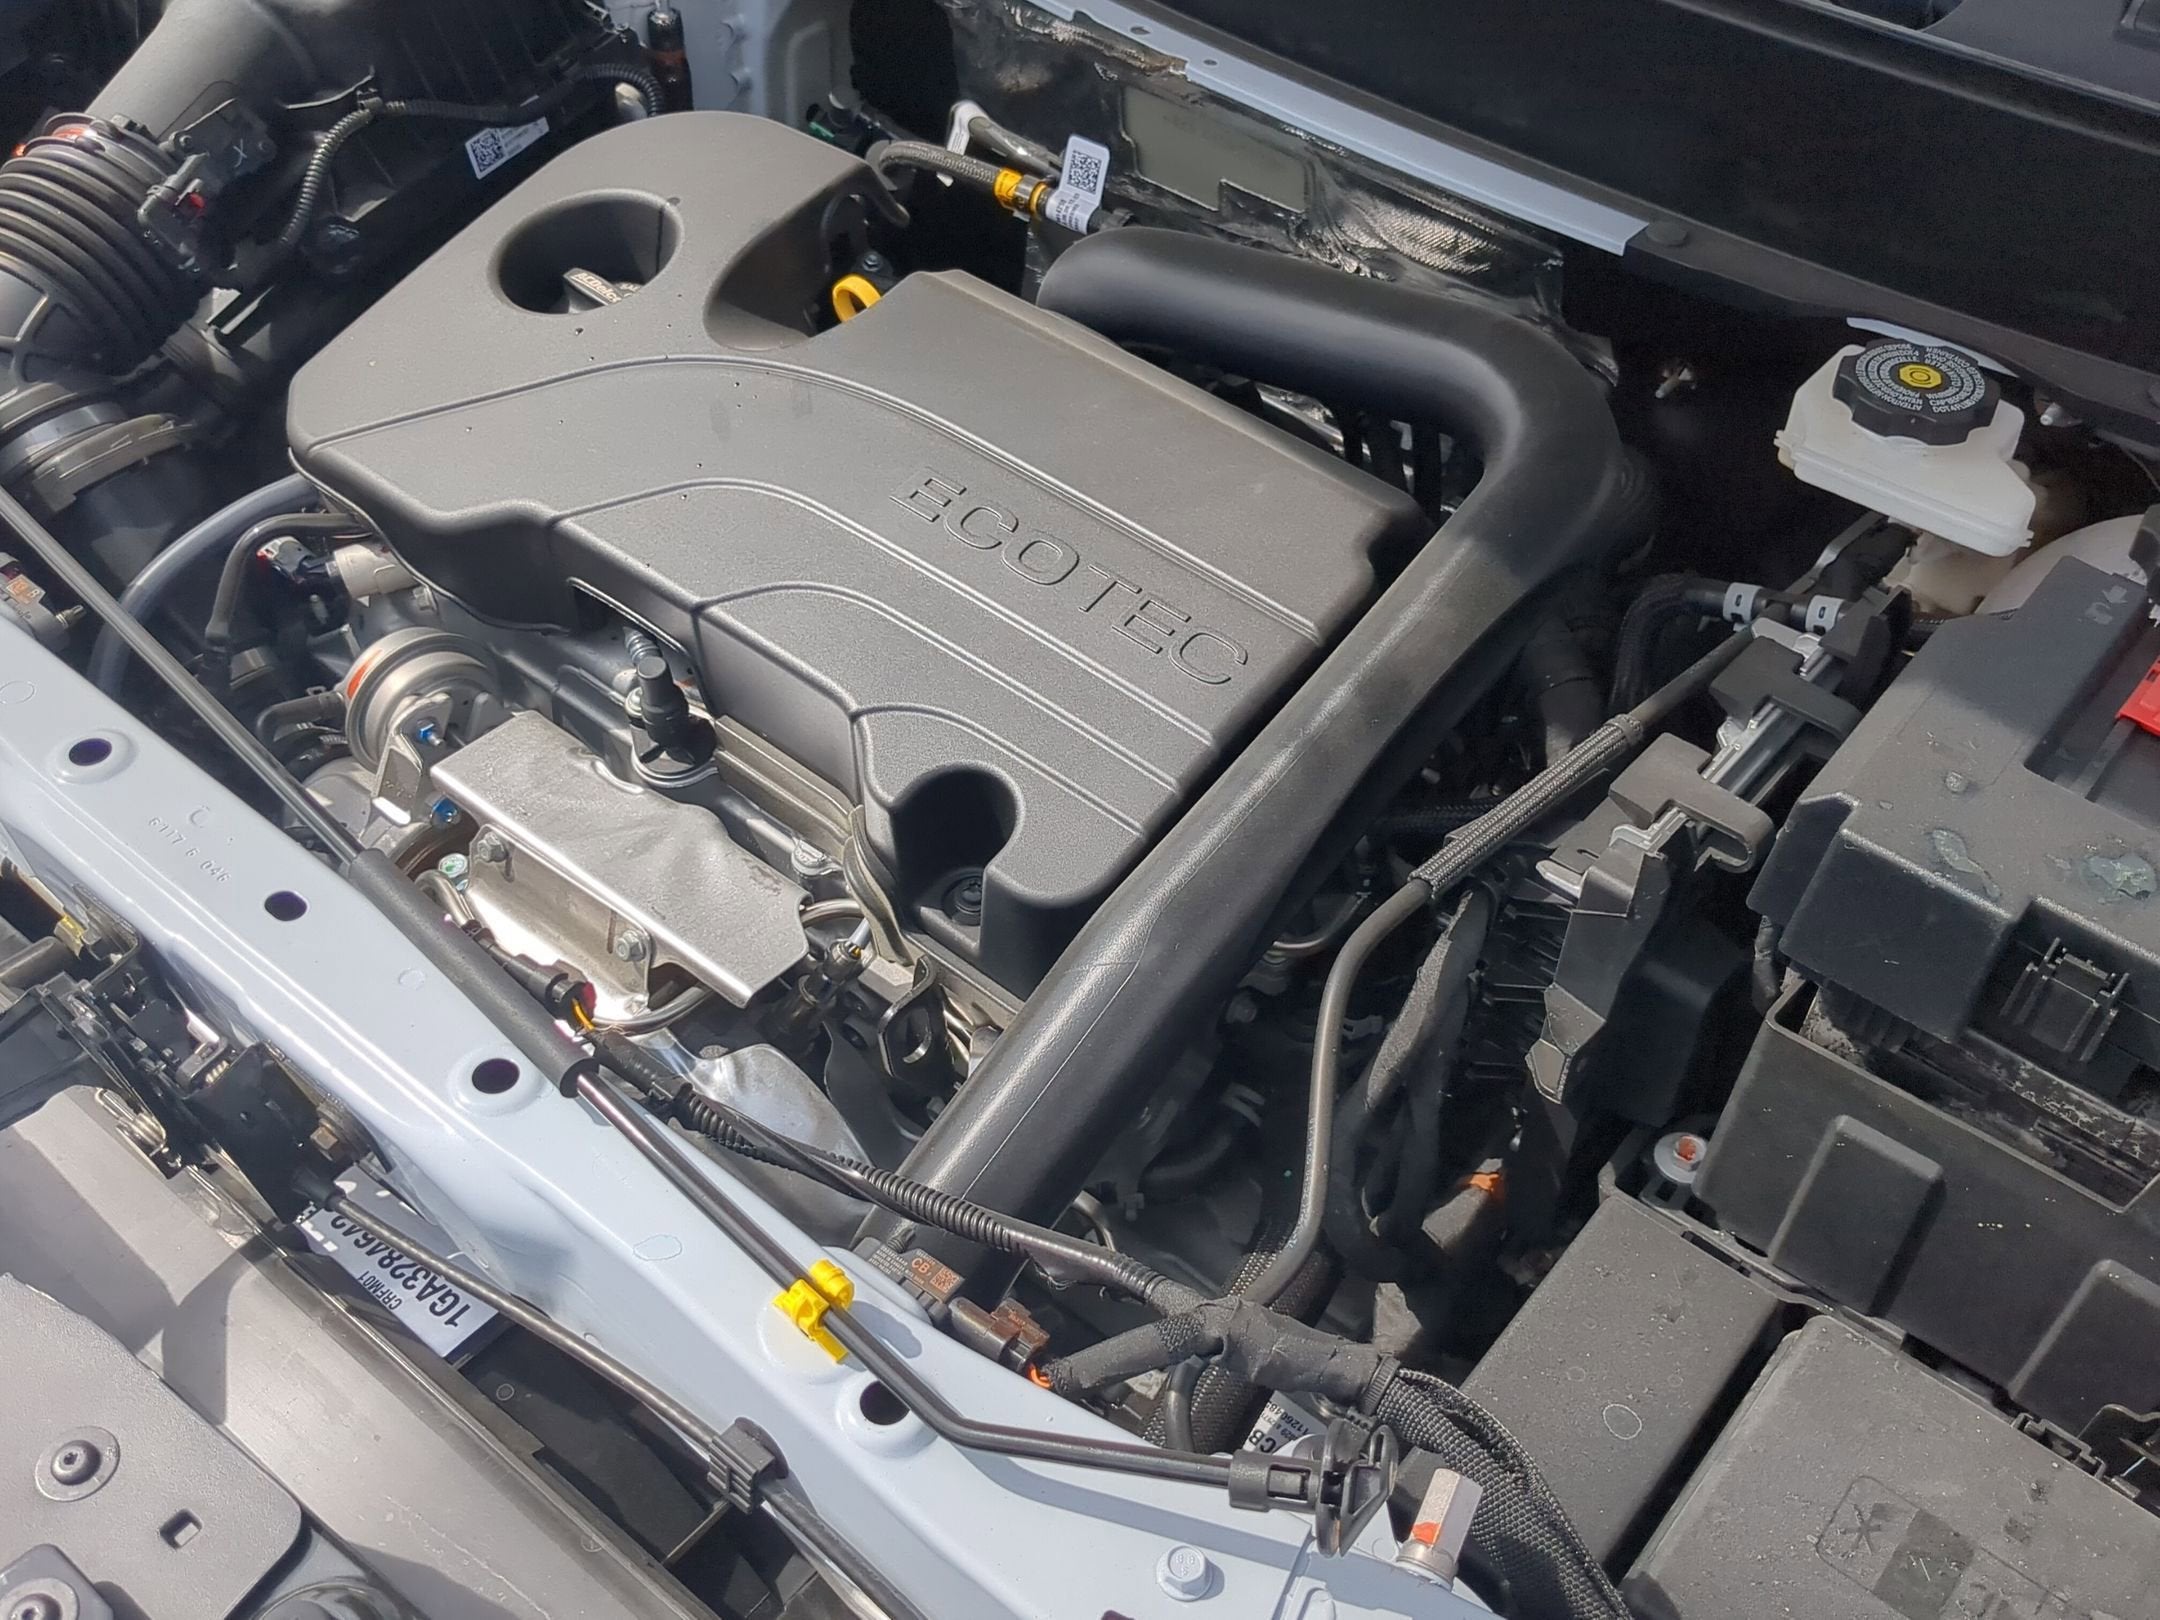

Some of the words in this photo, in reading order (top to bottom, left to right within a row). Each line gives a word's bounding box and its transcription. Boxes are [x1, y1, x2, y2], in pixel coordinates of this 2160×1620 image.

[888, 468, 1250, 685] ECOTEC
[357, 1270, 403, 1310] CRFM01
[1248, 1429, 1277, 1454] CB
